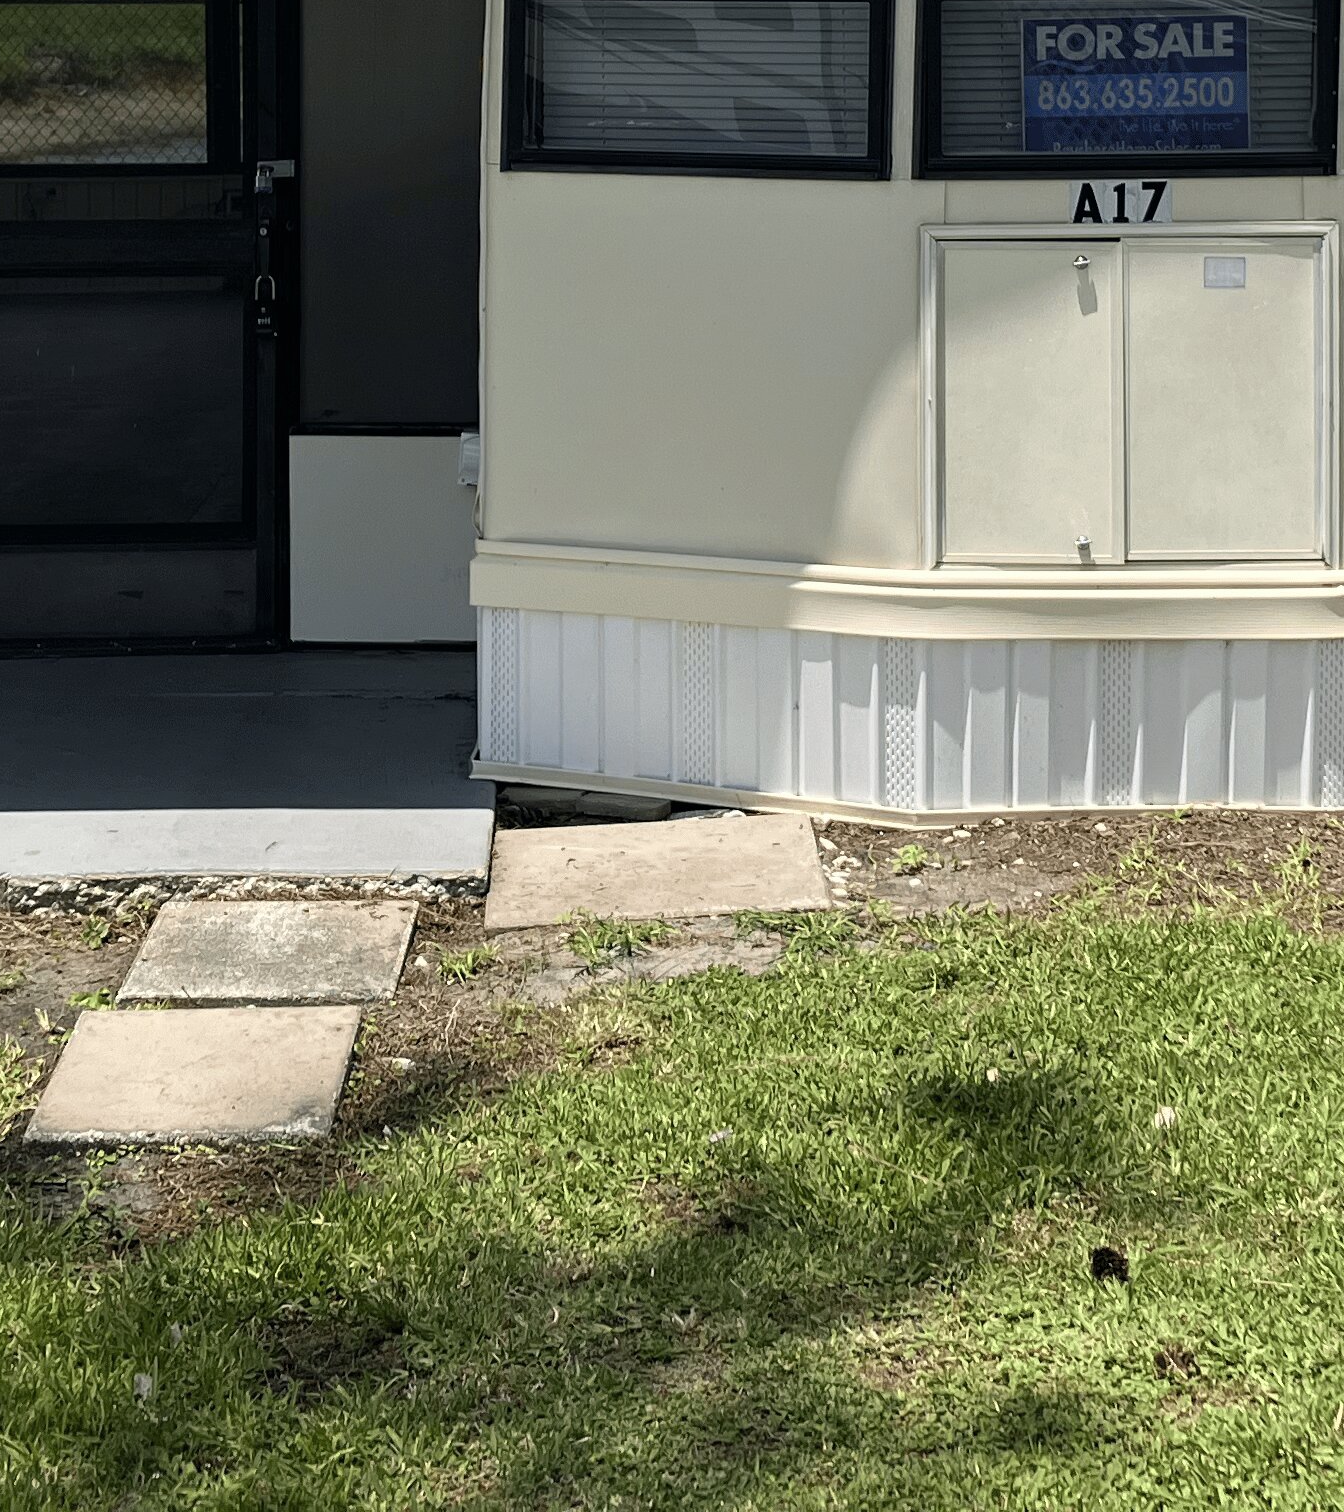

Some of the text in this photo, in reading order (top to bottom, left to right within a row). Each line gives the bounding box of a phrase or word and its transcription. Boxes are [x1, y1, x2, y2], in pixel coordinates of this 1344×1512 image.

[1036, 21, 1235, 61] FOR SALE
[1037, 76, 1235, 111] 863.635.2500
[1053, 138, 1222, 152] BayshoreHomeSalescom
[1072, 180, 1168, 224] A17
